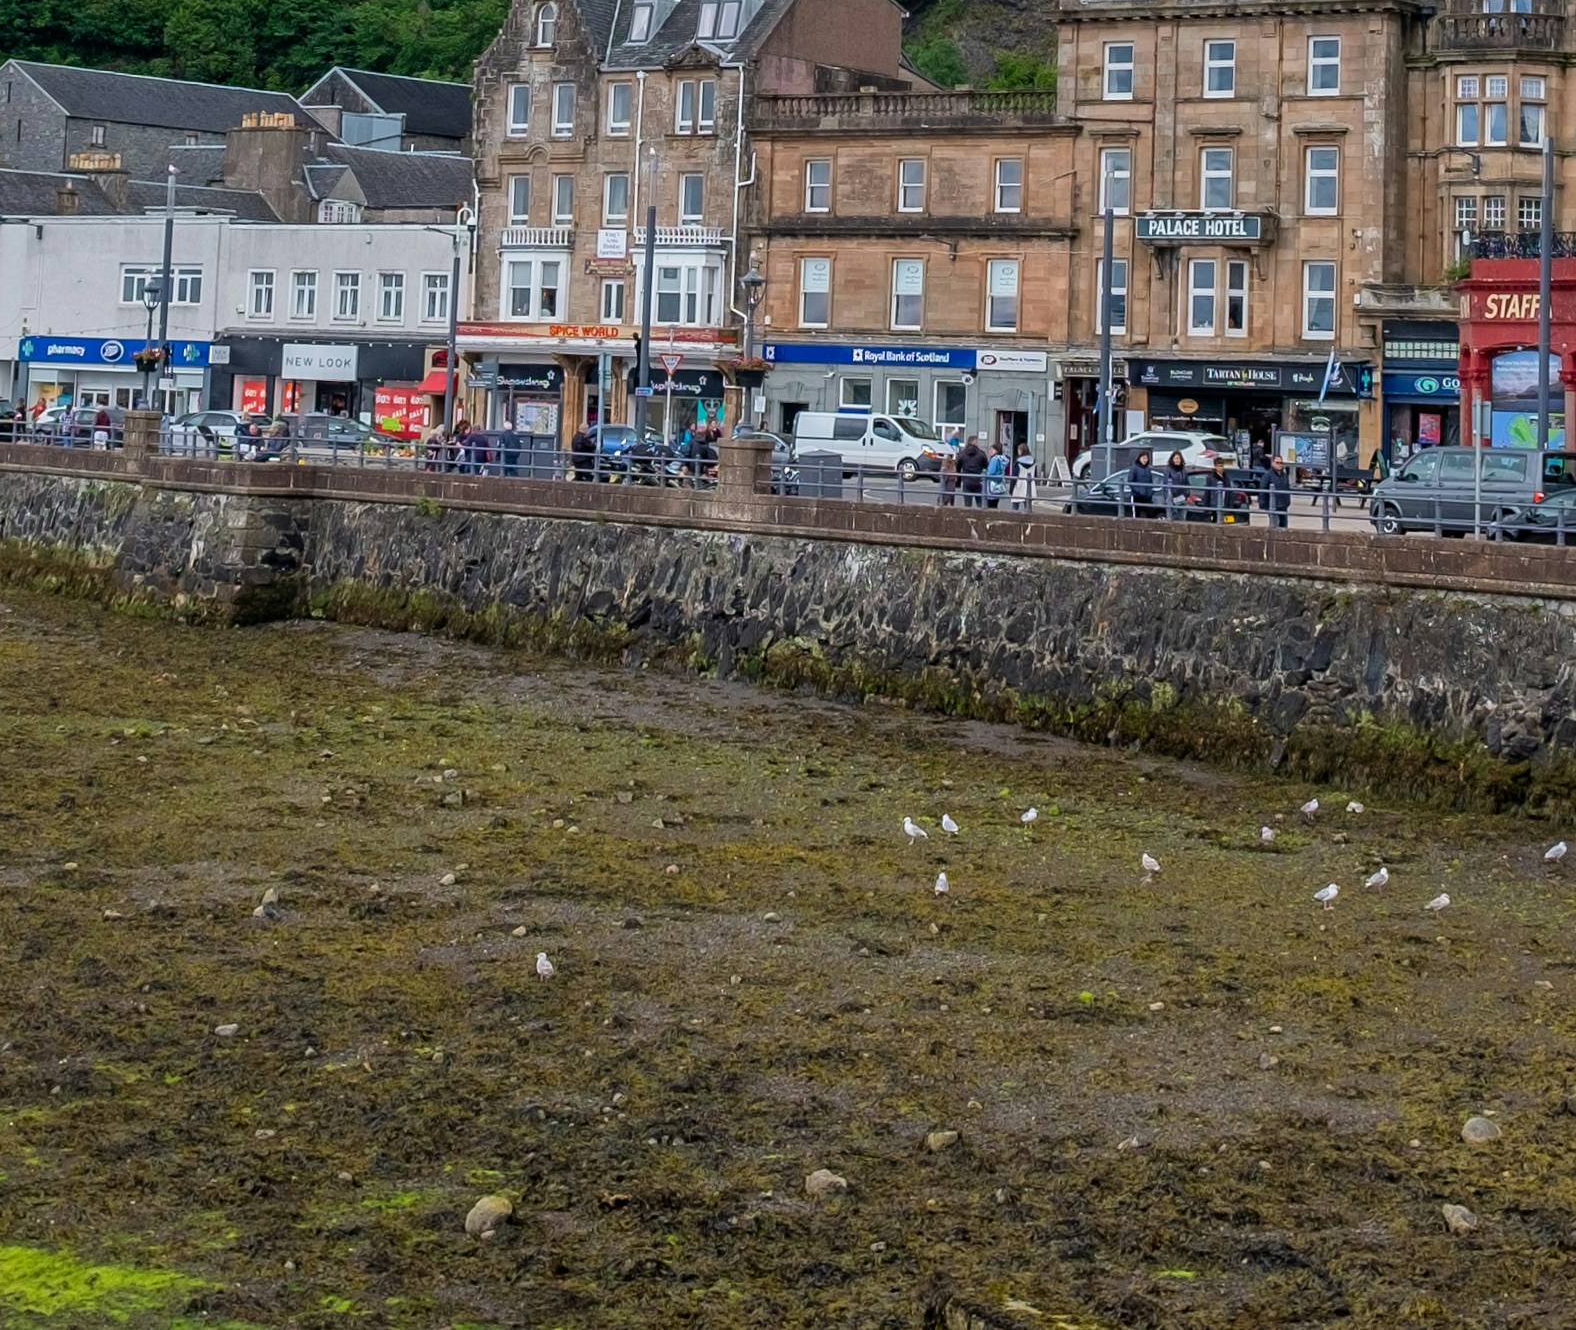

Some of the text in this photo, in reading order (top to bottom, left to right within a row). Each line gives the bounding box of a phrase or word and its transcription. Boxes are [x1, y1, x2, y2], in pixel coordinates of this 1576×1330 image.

[1148, 219, 1248, 236] PALACE HOTEL
[1484, 293, 1553, 319] STAFF
[549, 325, 619, 338] SPICE WORLD
[47, 344, 86, 357] pharmacy
[864, 350, 950, 363] Royal Bank of Scotland
[285, 356, 352, 368] NEW LOOK
[1206, 368, 1241, 379] TARTAN
[1248, 369, 1277, 381] HOUSE
